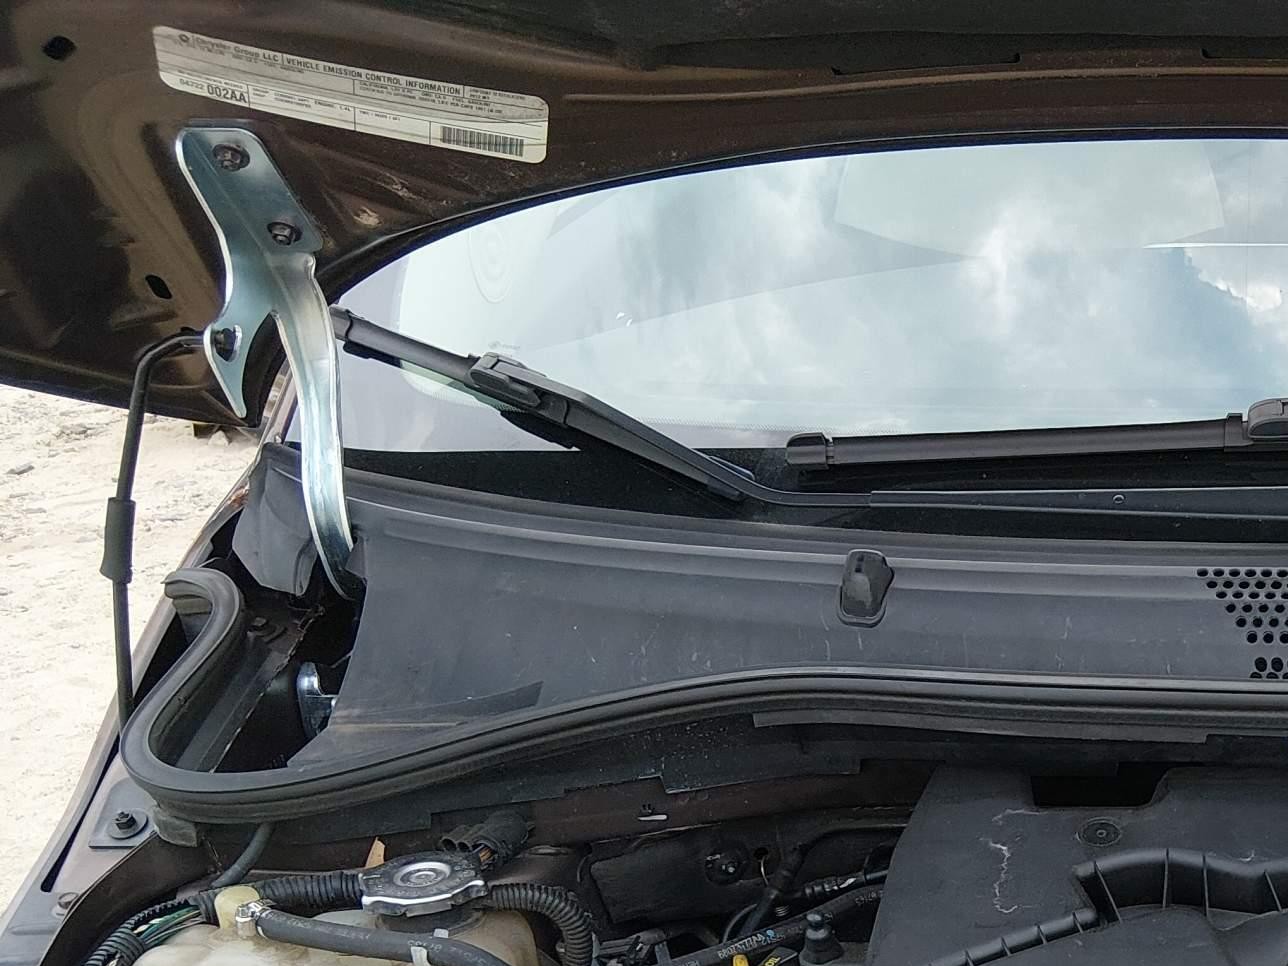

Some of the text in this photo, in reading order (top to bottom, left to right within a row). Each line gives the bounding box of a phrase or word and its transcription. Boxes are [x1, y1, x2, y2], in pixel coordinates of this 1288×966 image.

[234, 44, 260, 59] Group
[263, 52, 279, 62] LLC
[286, 56, 320, 71] VEHICLE
[323, 63, 362, 78] EMISSION
[365, 72, 402, 86] CONTROL
[405, 80, 461, 95] INFORMATION
[207, 83, 247, 103] 002AA
[765, 956, 781, 966] OIL
